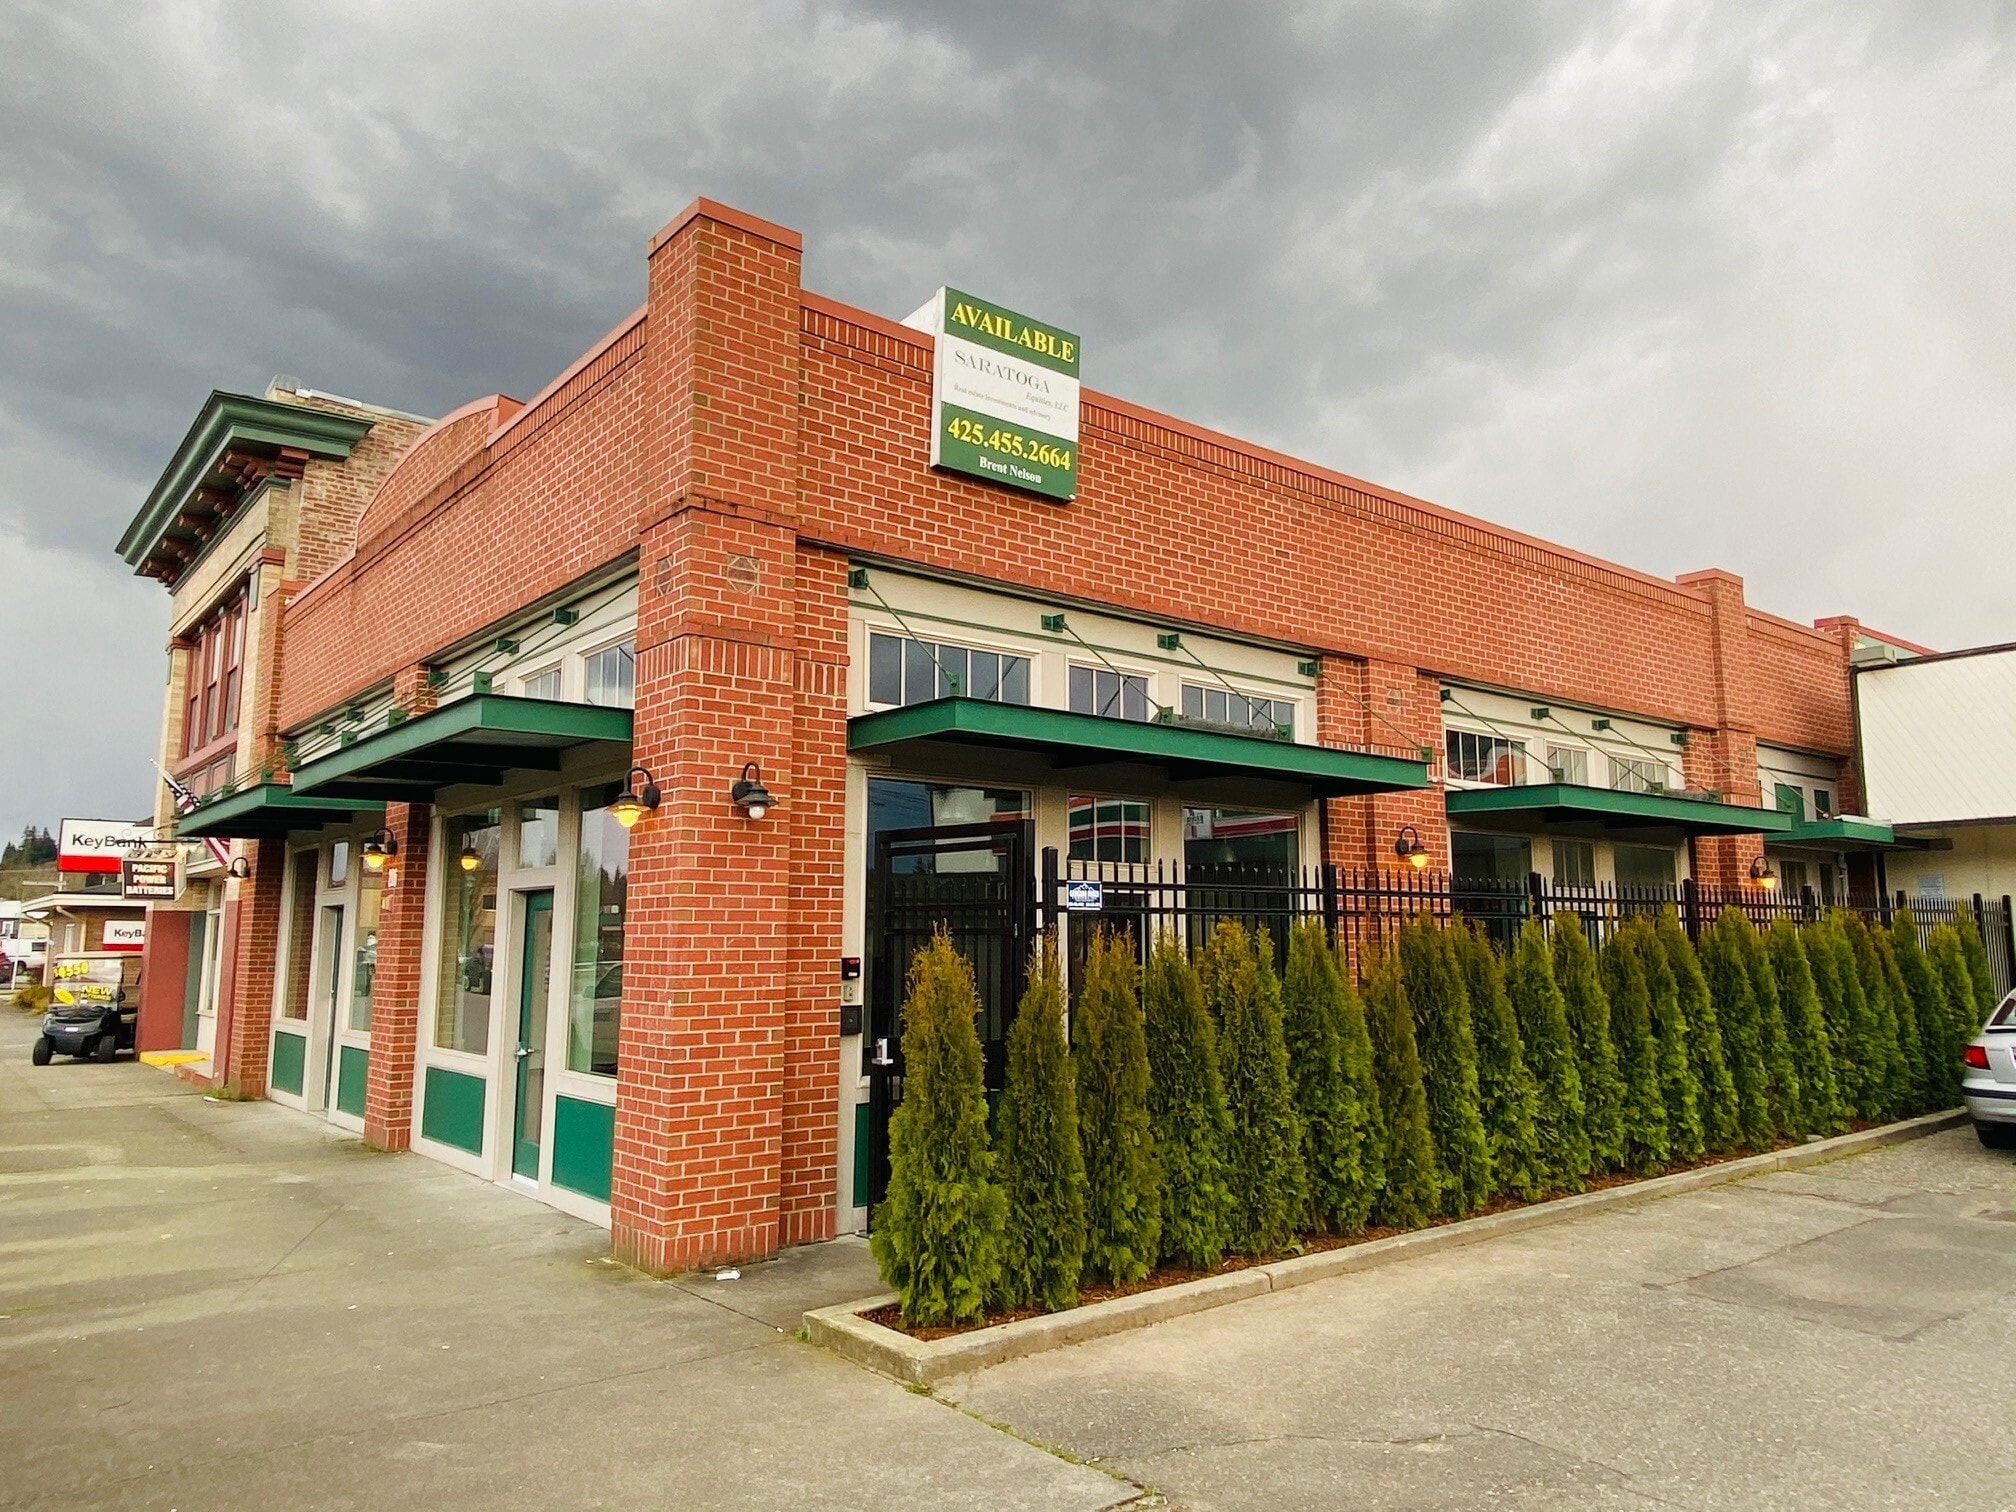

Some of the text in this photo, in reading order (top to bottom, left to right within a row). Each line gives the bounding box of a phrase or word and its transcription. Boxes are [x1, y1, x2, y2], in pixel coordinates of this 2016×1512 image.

[950, 302, 1075, 363] AVAILABLE
[954, 349, 1051, 394] SARATOGA
[1054, 401, 1069, 413] LLC
[947, 416, 1071, 471] 425.455.2664
[979, 456, 1042, 484] Brent Nelson
[72, 834, 147, 849] KeyBank
[132, 863, 168, 873] PACIFIC
[133, 874, 167, 884] POWER
[126, 885, 174, 895] BATTERIES
[114, 929, 145, 938] KeyB
[81, 985, 112, 996] NEW
